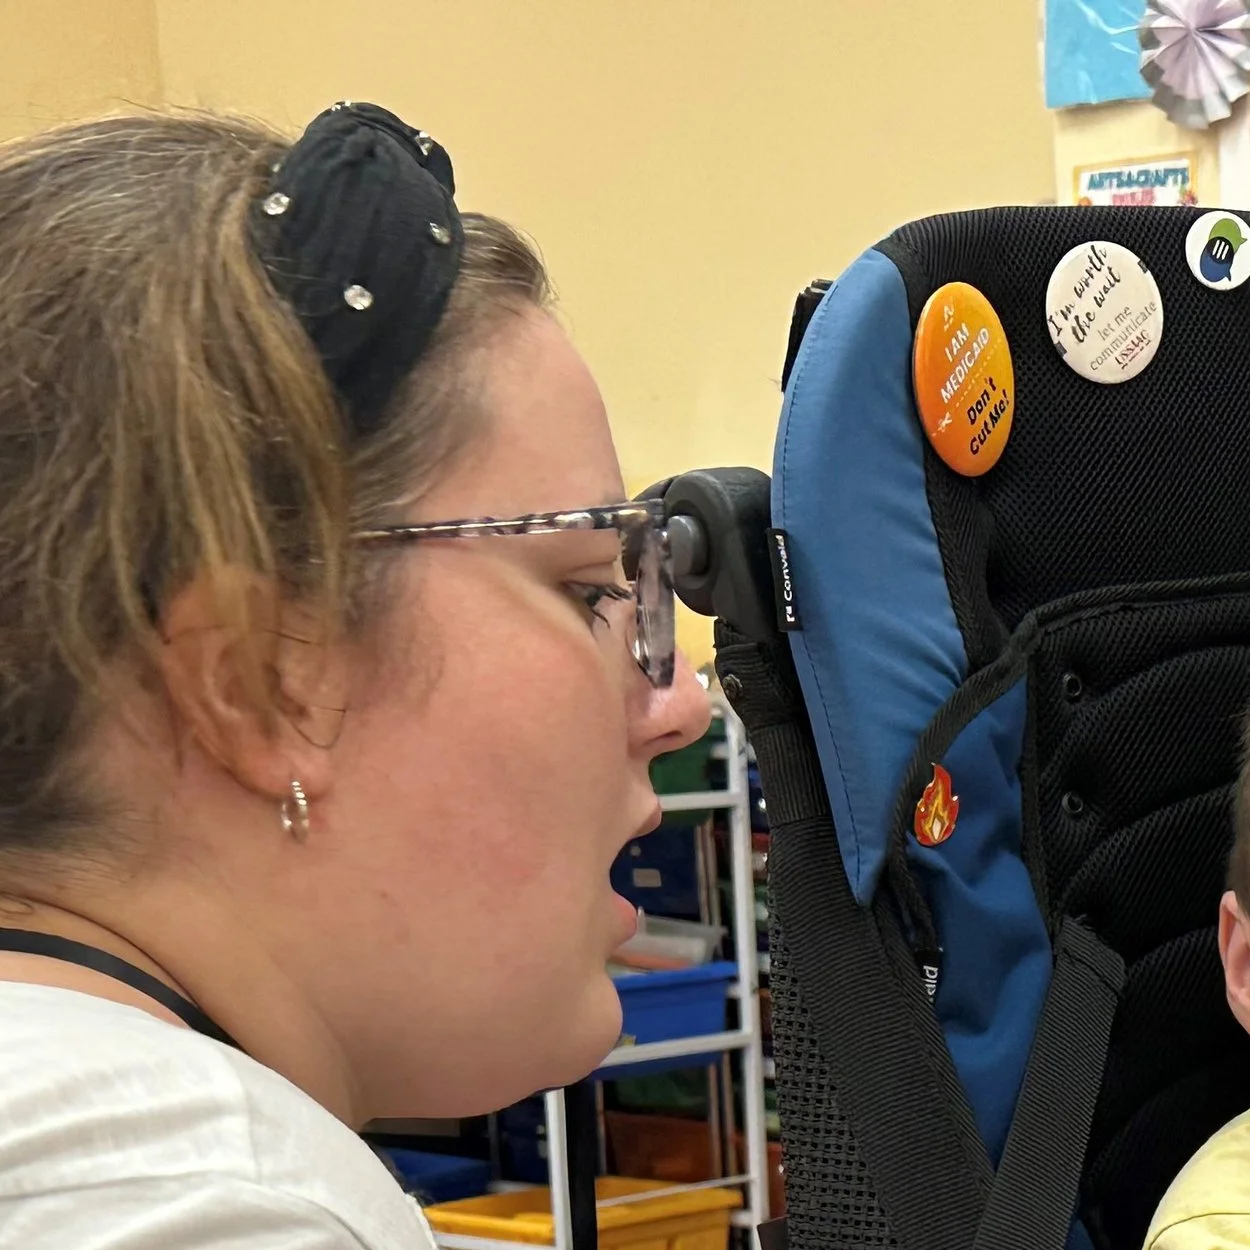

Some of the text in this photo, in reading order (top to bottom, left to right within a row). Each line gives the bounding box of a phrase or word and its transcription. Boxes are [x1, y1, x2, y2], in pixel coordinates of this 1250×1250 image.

[1071, 265, 1121, 343] the wait
[1073, 244, 1108, 299] worth
[944, 322, 970, 363] I AM
[1089, 301, 1158, 371] communicate
[1097, 305, 1132, 341] let me
[939, 327, 990, 404] MEDICAID
[966, 376, 997, 426] Don't
[969, 388, 1010, 456] Cut Me!
[775, 534, 793, 602] Convaid
